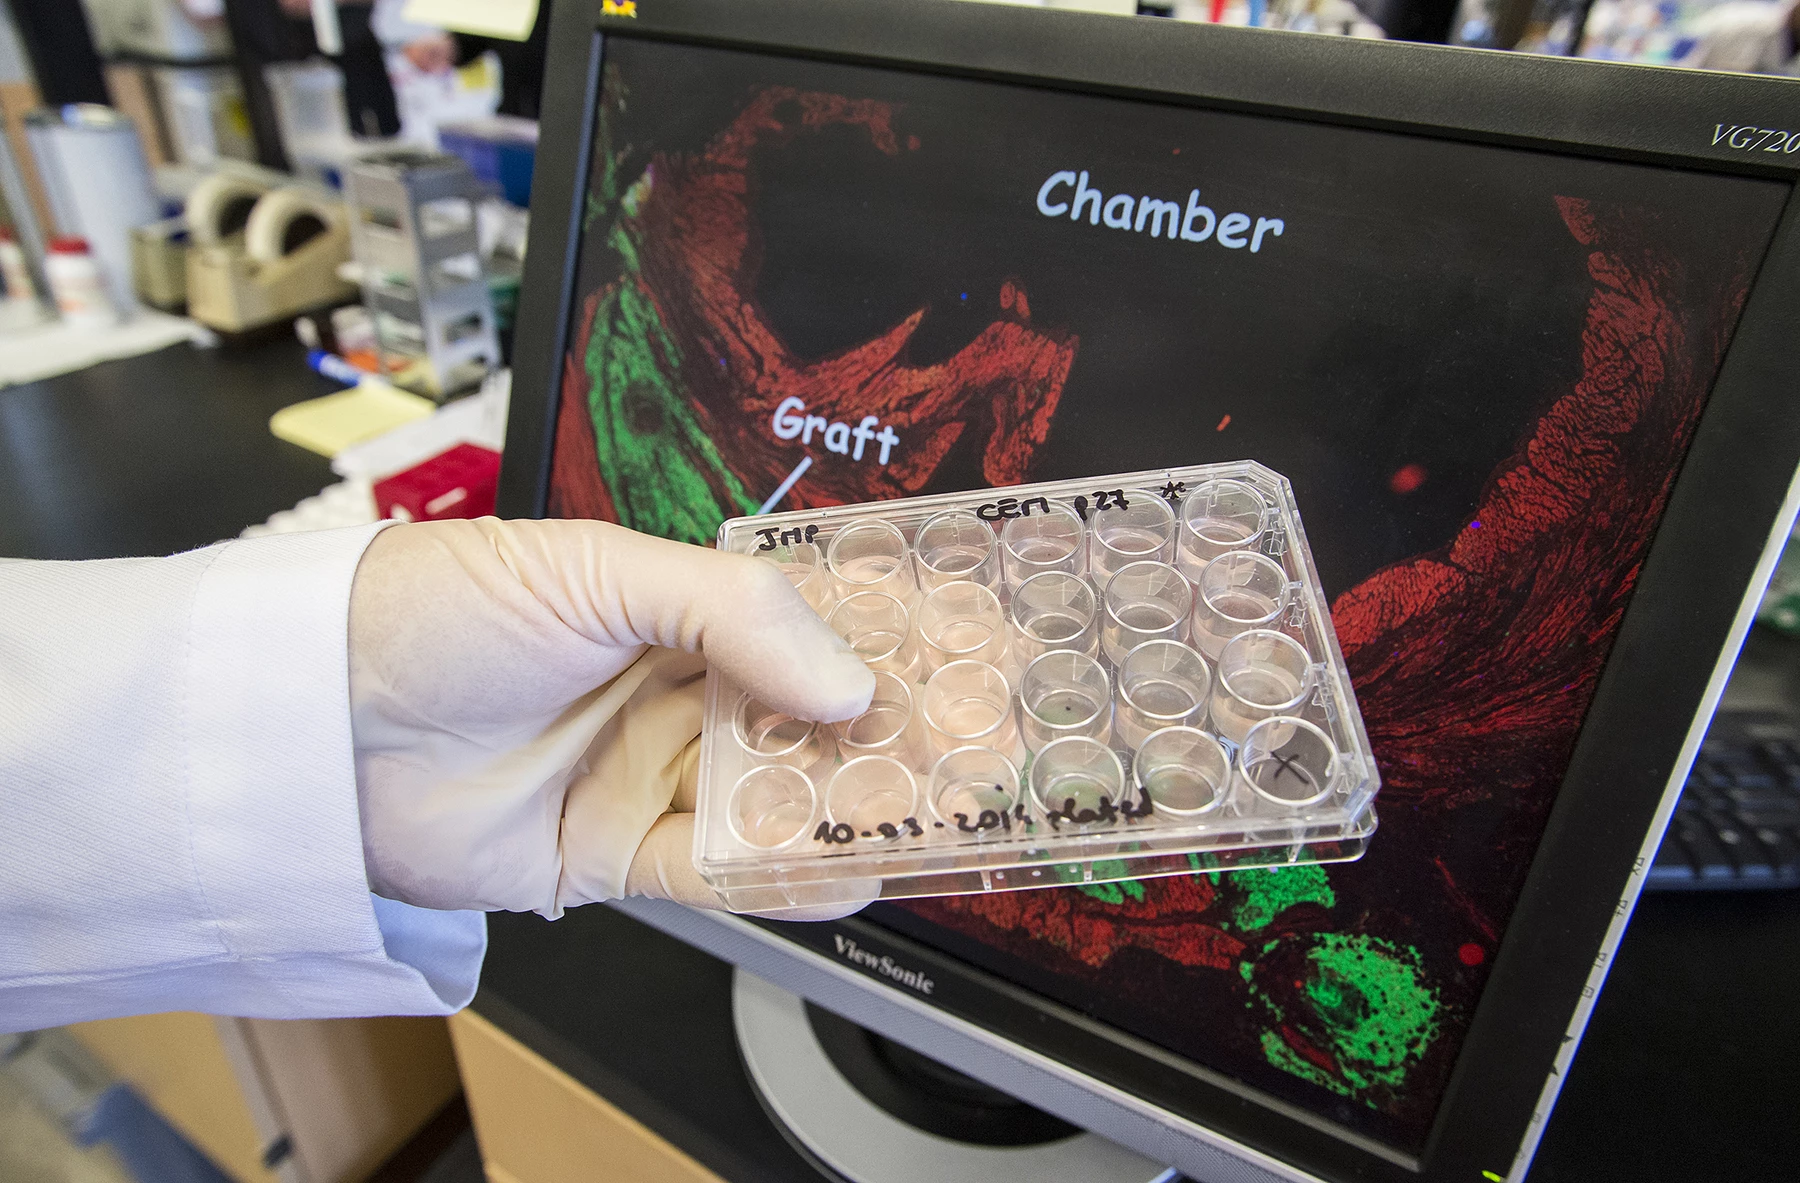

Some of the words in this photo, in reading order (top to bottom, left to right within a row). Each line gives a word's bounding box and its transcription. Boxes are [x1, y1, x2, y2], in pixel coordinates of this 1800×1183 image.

[1036, 170, 1285, 253] Chamber
[772, 396, 900, 466] Graft
[755, 524, 819, 551] JMP
[834, 933, 935, 995] ViewSonic
